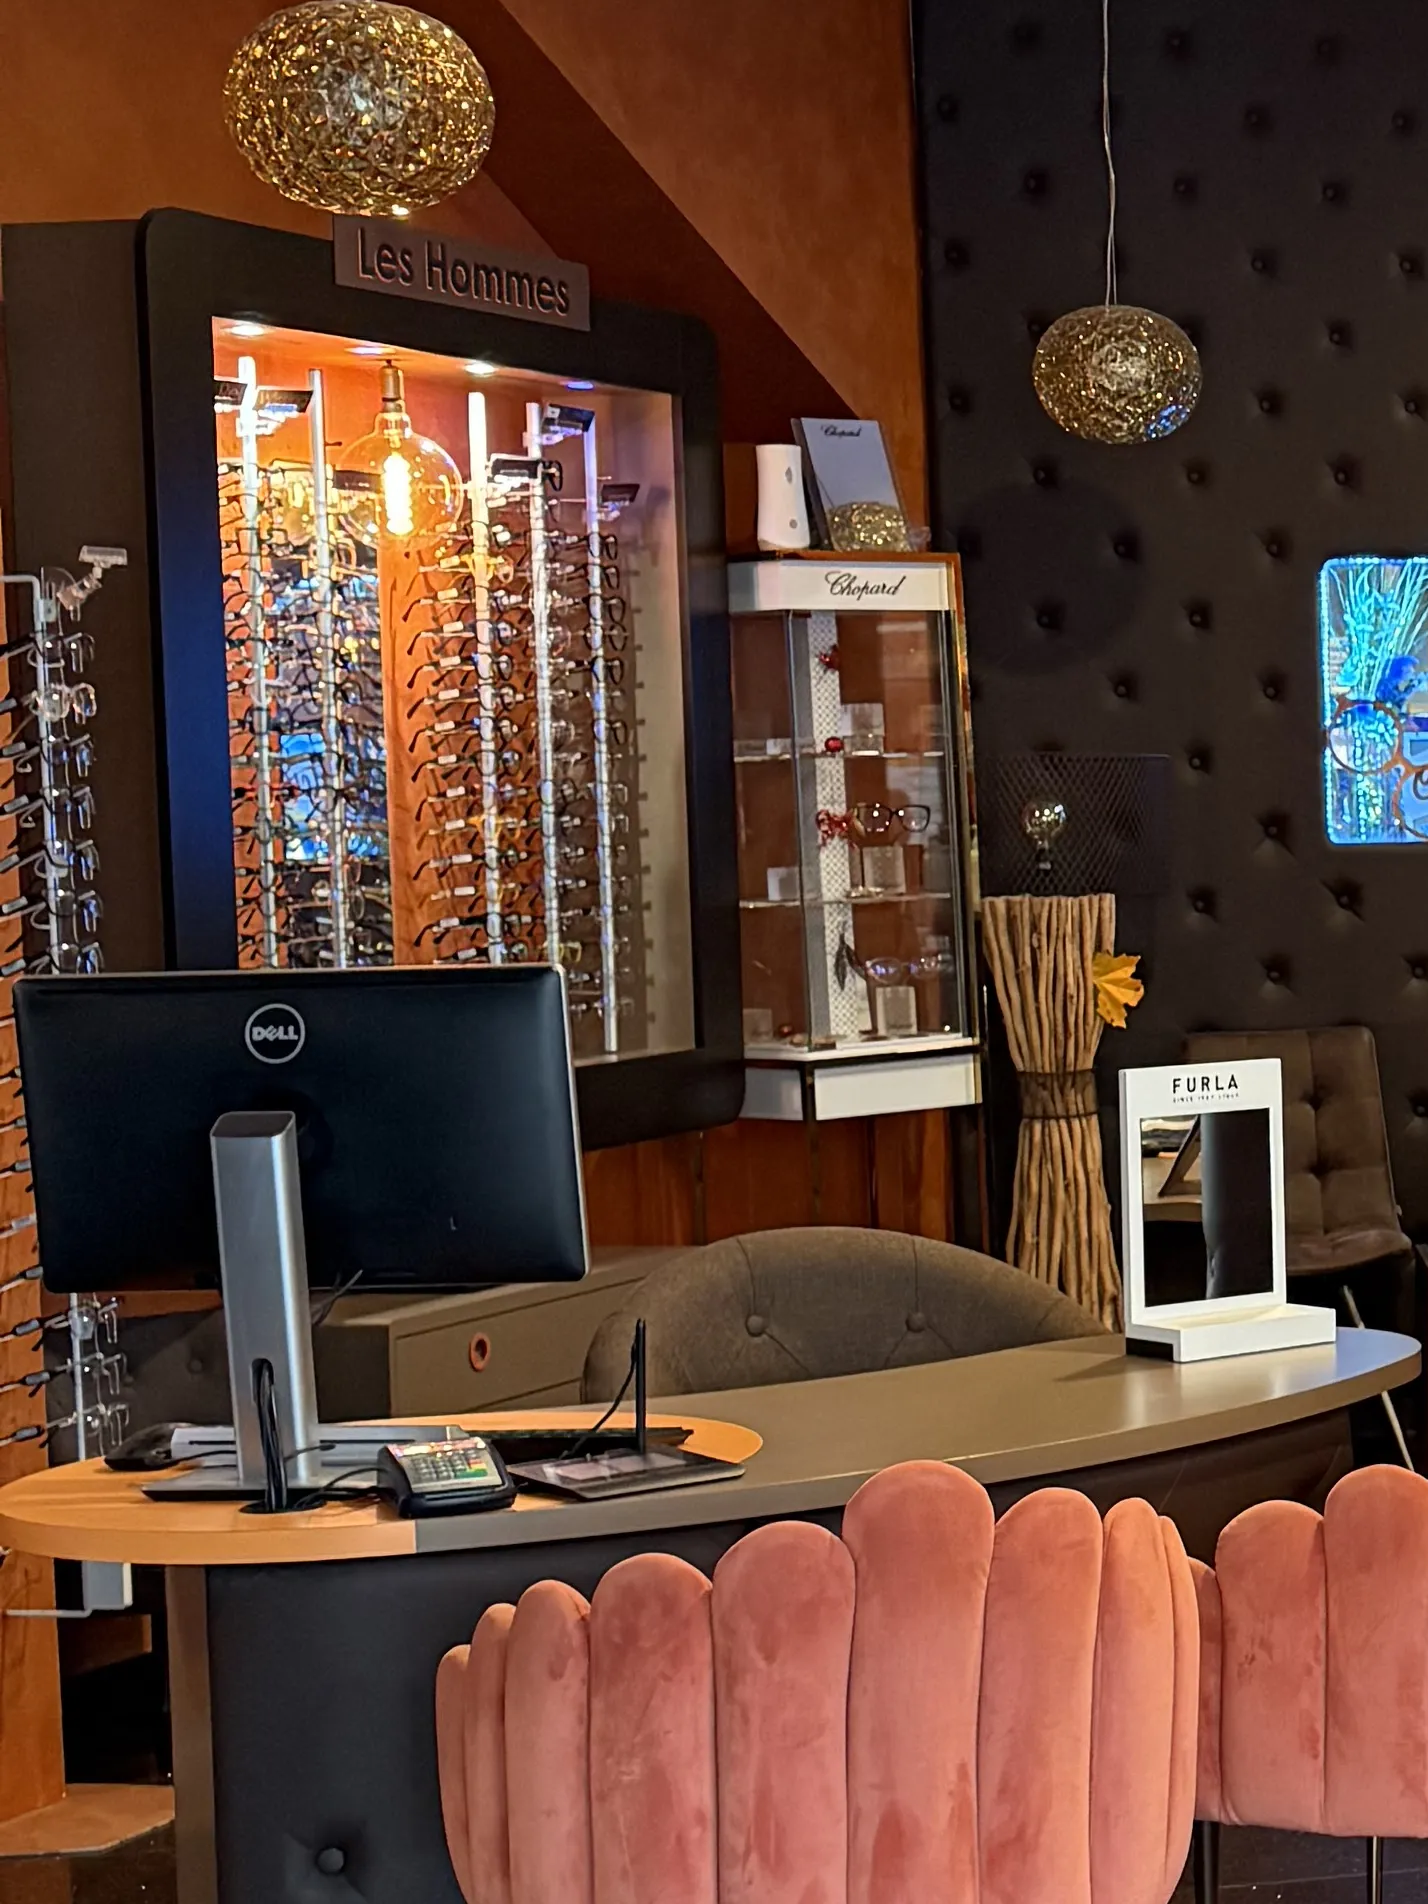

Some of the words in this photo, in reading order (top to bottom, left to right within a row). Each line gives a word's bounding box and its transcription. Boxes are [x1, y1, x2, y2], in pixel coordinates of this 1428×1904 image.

[357, 226, 414, 285] Les
[425, 241, 571, 316] Hommes
[824, 570, 907, 601] Chopard
[251, 1024, 299, 1042] DELL
[1172, 1074, 1239, 1094] FURLA
